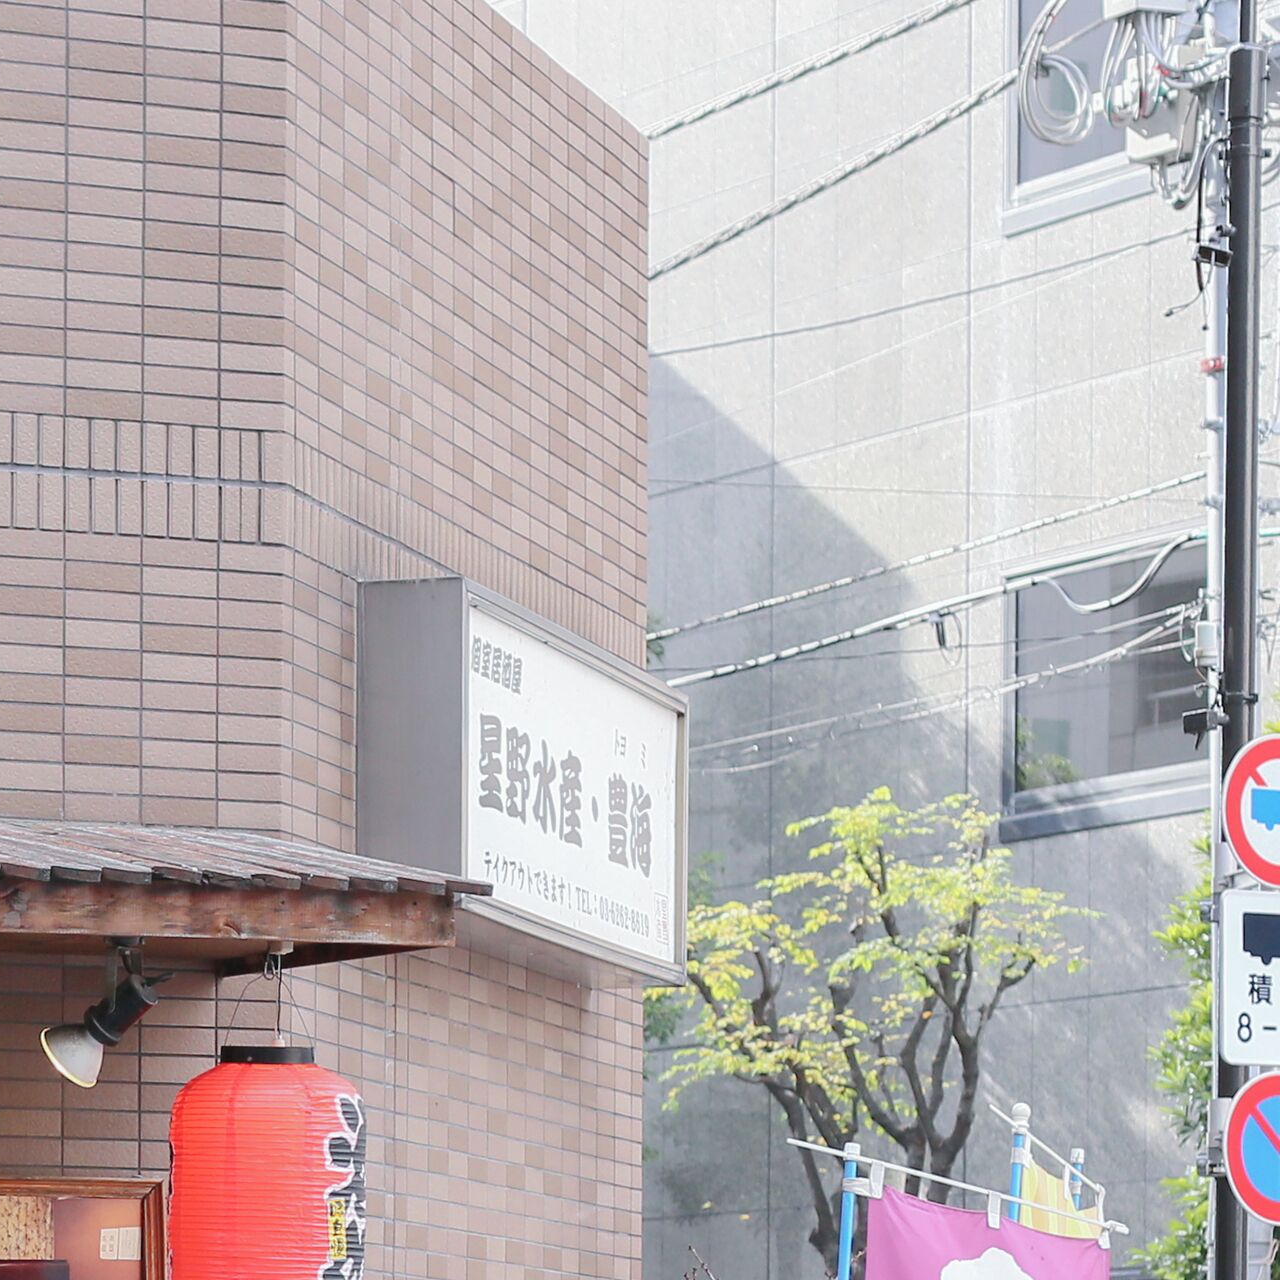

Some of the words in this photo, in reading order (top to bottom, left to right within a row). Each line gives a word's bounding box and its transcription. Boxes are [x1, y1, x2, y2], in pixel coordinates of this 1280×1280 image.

[478, 713, 652, 878] 星野水産・豊海
[1247, 973, 1274, 1005] 積
